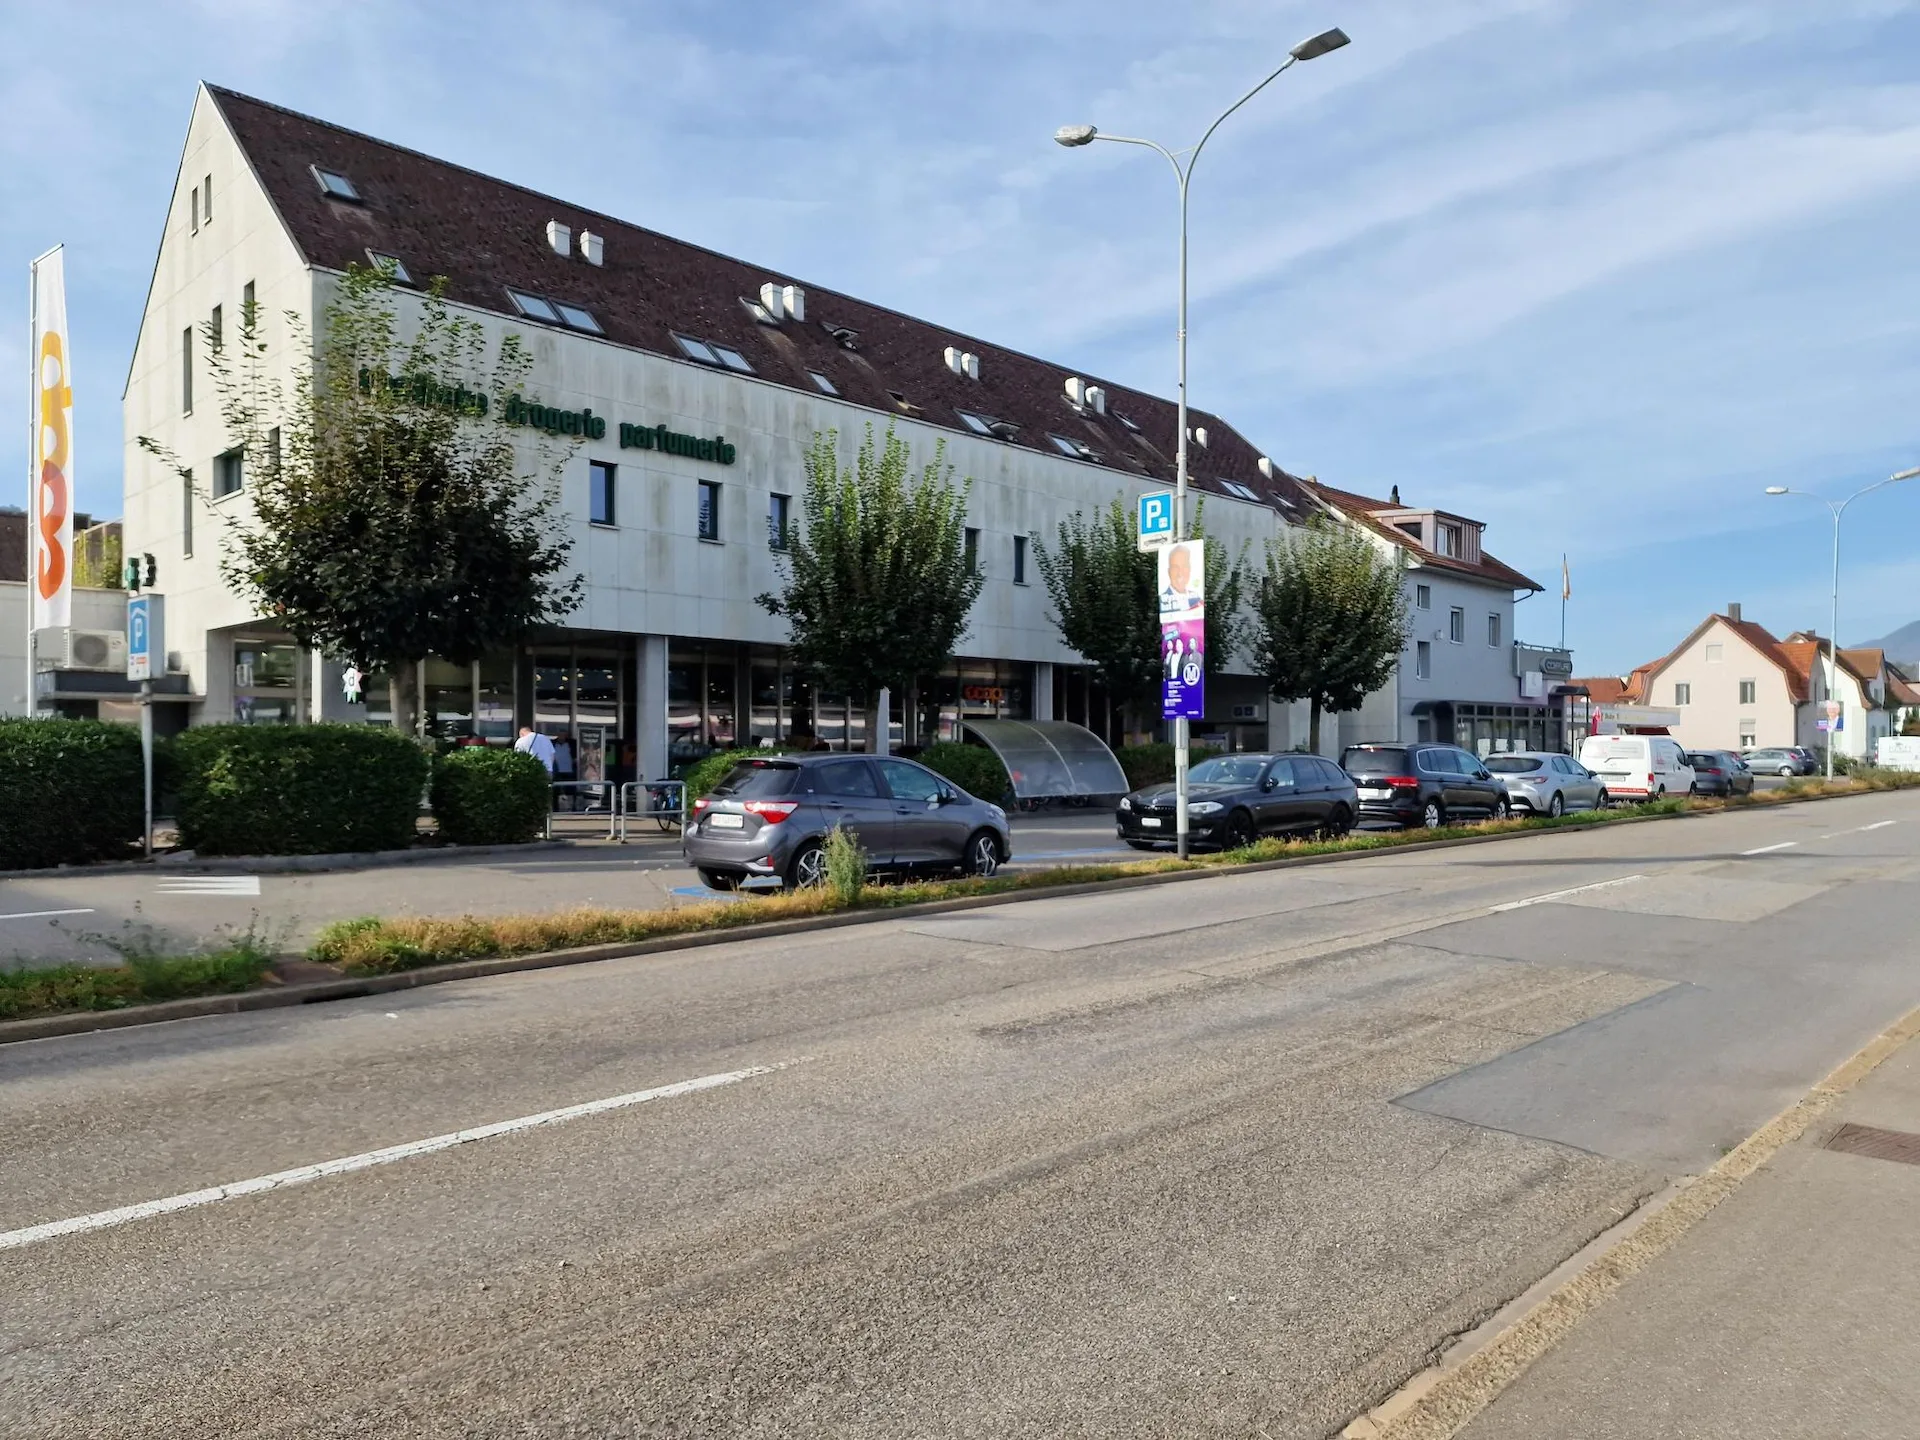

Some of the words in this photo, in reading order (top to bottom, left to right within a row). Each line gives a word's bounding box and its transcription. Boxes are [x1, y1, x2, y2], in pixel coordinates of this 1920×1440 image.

[504, 394, 606, 440] drogerie
[619, 422, 736, 465] parfumerie
[1146, 499, 1162, 529] P
[134, 617, 143, 648] P
